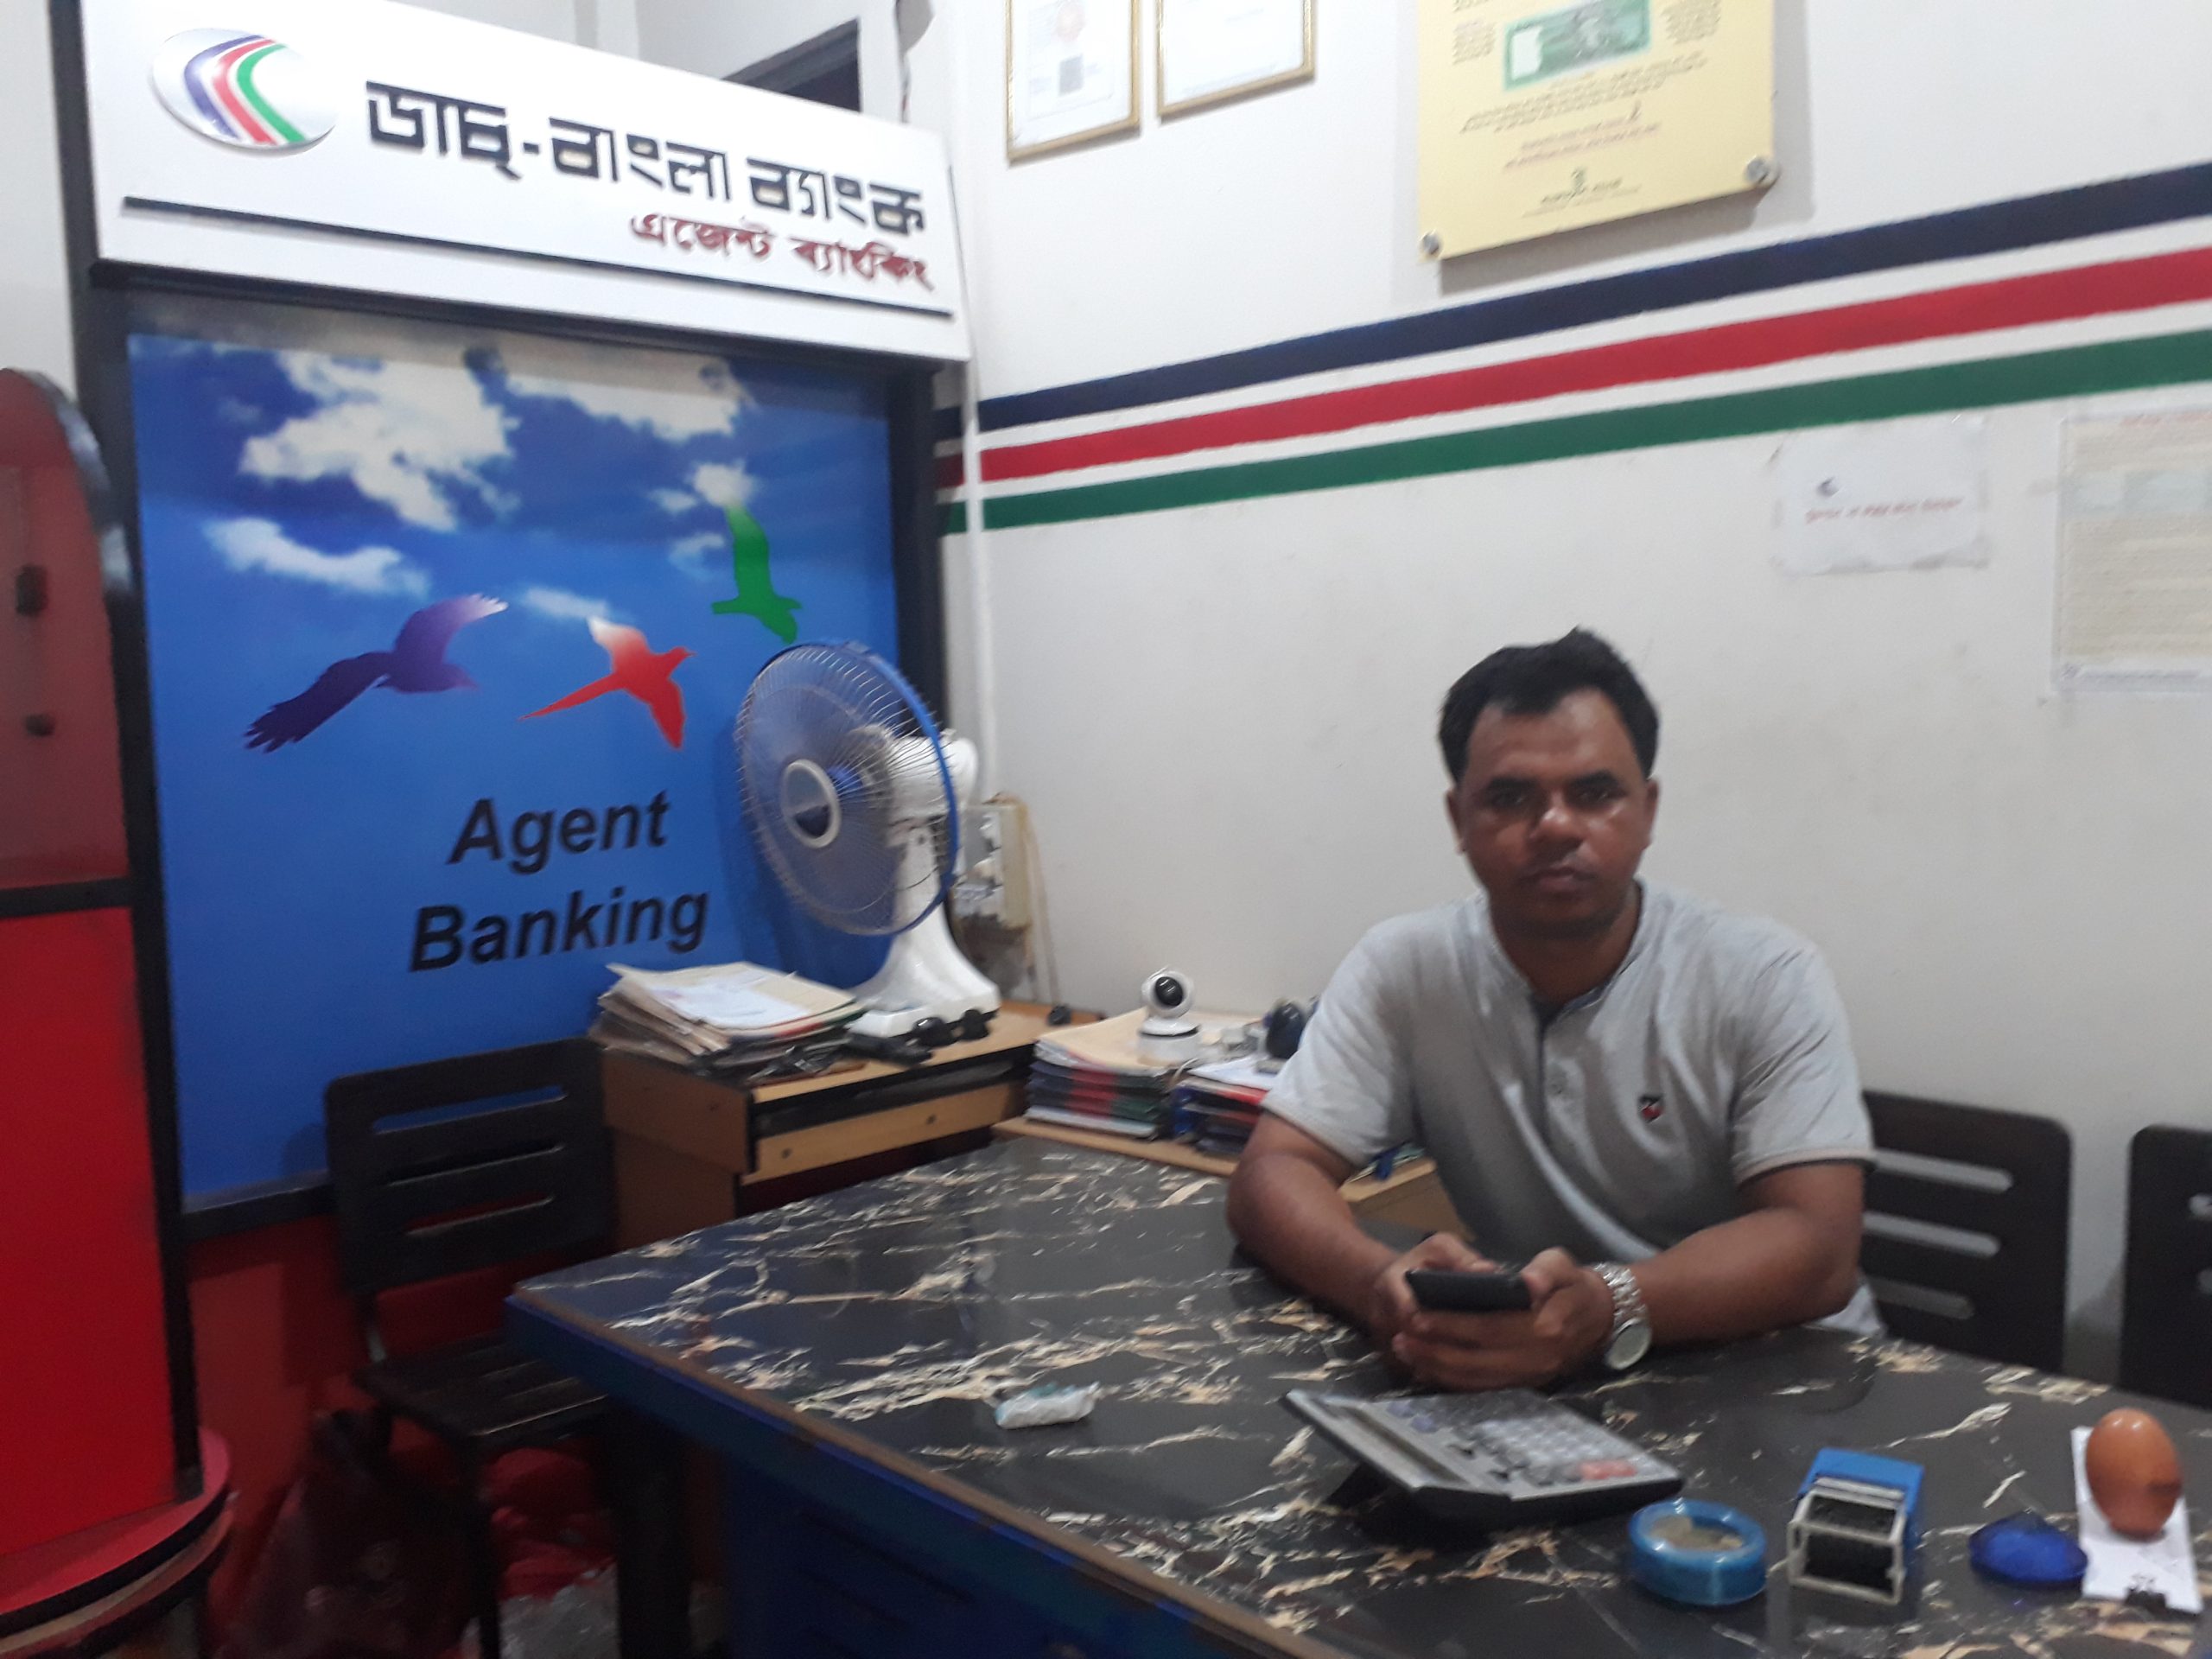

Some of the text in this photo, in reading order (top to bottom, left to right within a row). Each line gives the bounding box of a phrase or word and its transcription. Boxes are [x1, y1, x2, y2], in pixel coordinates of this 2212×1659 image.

[631, 213, 775, 257] এজেন্ট
[746, 156, 925, 237] ব্যাংক
[447, 789, 671, 875] Agent
[409, 886, 709, 973] Banking
